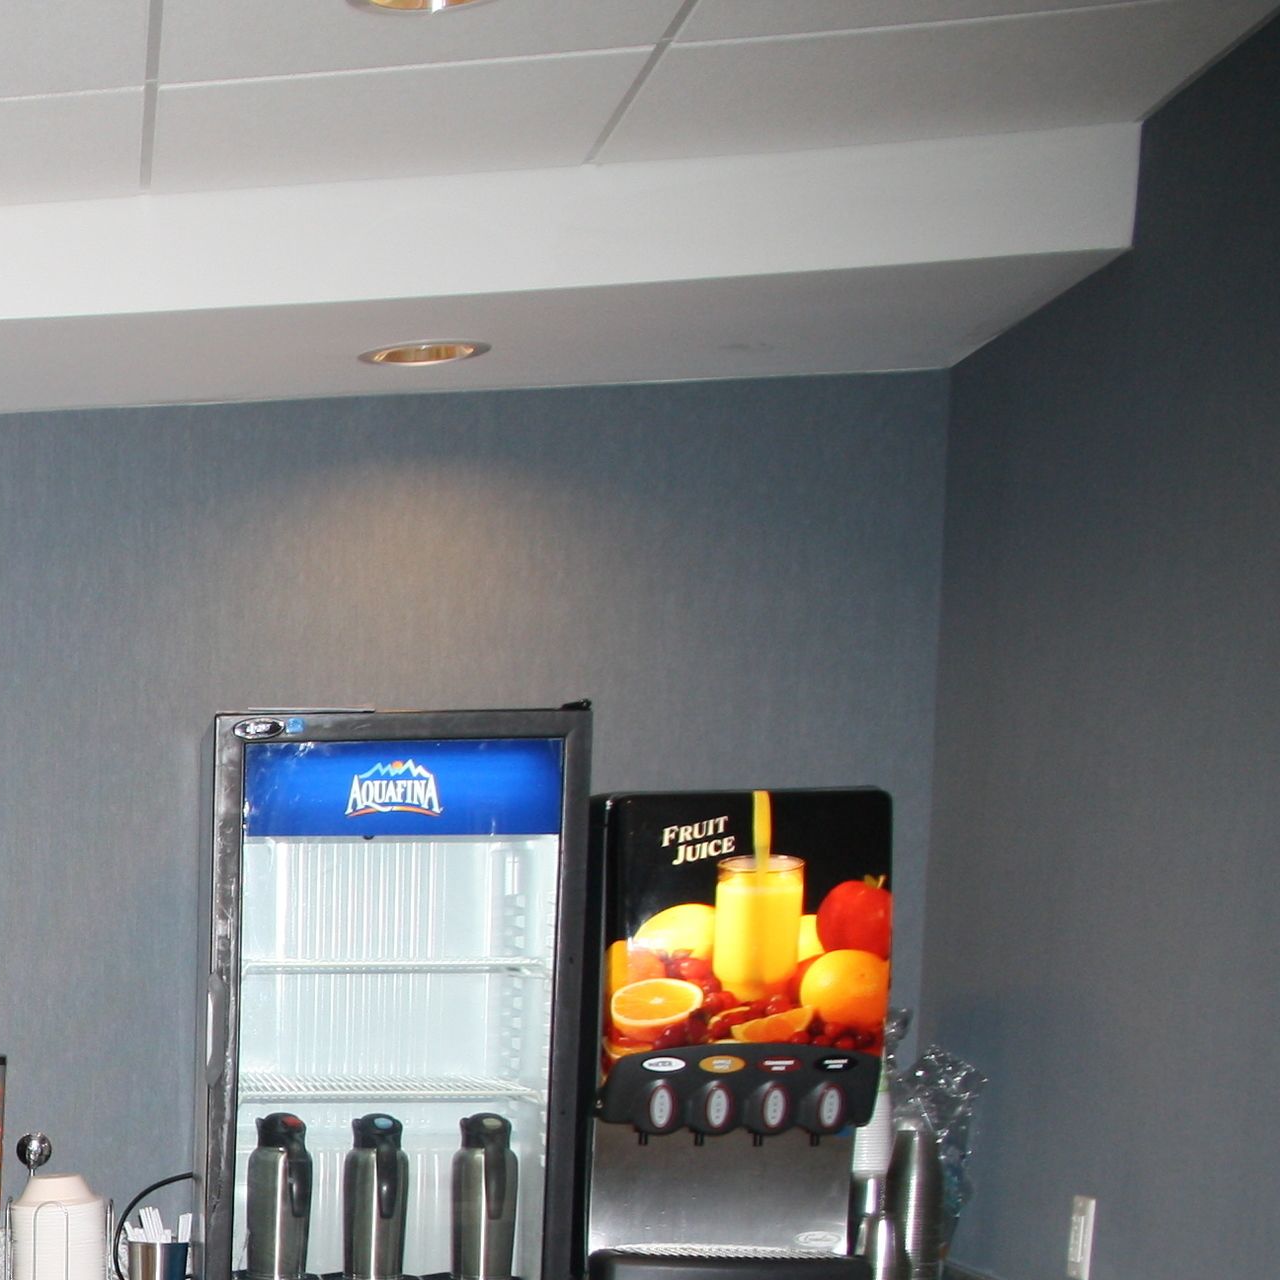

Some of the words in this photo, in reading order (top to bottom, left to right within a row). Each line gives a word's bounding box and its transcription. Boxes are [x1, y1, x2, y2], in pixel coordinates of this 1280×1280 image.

[344, 774, 442, 814] AQUAFINA
[661, 815, 729, 848] FRUIT
[671, 835, 736, 866] JUICE
